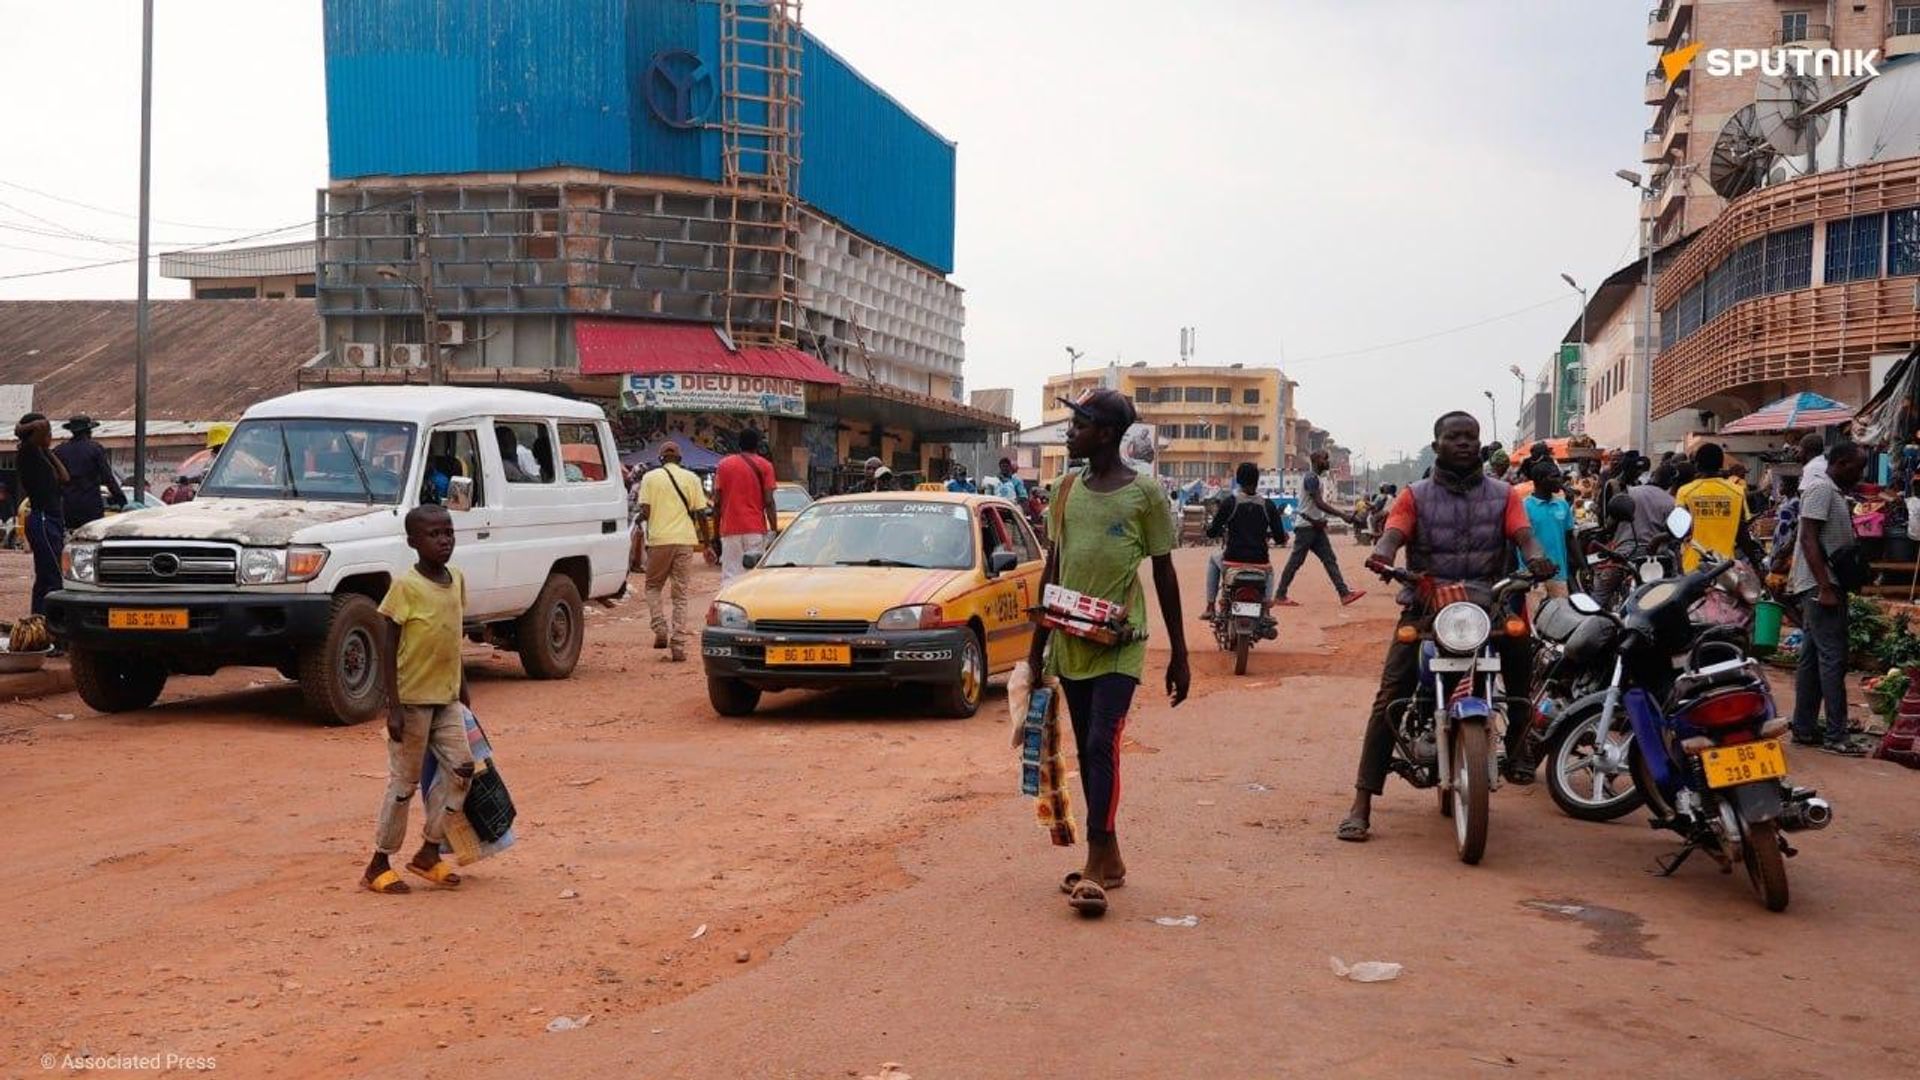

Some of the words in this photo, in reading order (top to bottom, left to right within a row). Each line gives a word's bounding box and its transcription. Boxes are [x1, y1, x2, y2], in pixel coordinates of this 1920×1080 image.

[630, 375, 675, 390] ETS
[681, 375, 732, 391] DIEU
[738, 377, 801, 396] DONNE
[903, 504, 944, 513] DIVINE
[784, 648, 797, 661] BG
[1737, 746, 1756, 761] BG
